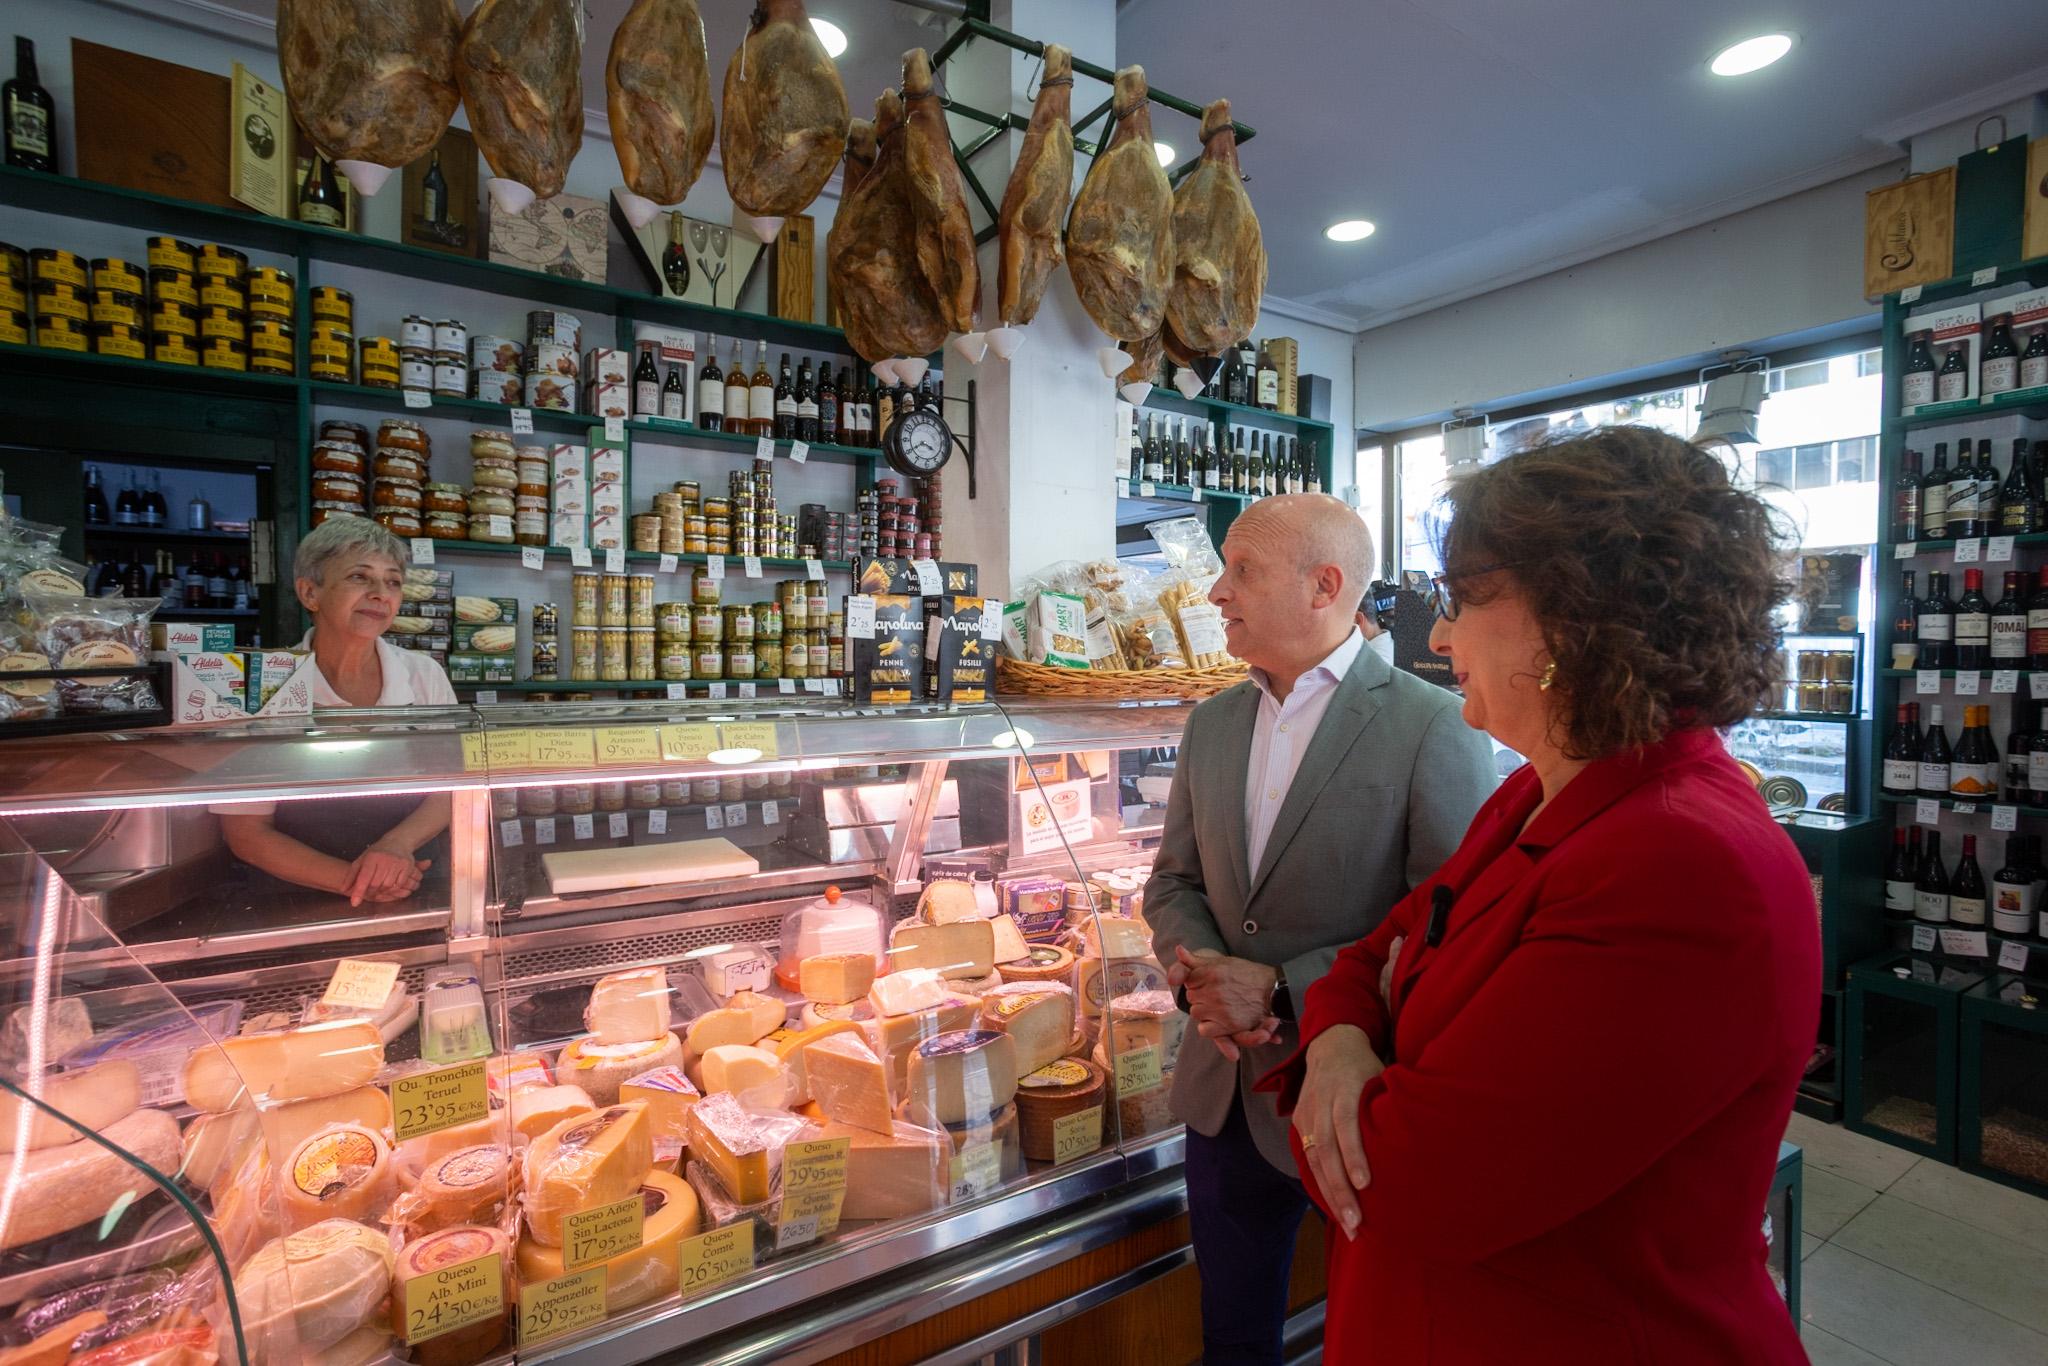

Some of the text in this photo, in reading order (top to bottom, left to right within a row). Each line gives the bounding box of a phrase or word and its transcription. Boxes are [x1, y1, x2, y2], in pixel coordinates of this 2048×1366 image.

[874, 613, 924, 636] apolina
[942, 614, 983, 636] Napol
[1992, 622, 2026, 633] POMAL
[538, 747, 572, 761] 17'95
[606, 744, 635, 757] 9'50
[668, 741, 701, 754] 10'95
[398, 1065, 484, 1093] Qu. Tronchón
[1120, 1073, 1147, 1090] 28'50
[423, 1083, 462, 1101] Teruel
[400, 1102, 456, 1130] 23'95
[804, 1144, 832, 1153] Queso
[1058, 1136, 1086, 1155] 20'50
[788, 1167, 826, 1187] 29'95
[569, 1199, 638, 1227] Queso Añejo
[573, 1215, 633, 1241] Sin Lactosa
[703, 1231, 734, 1246] Queso
[573, 1236, 617, 1261] 17'95
[437, 1265, 477, 1284] Queso
[684, 1260, 729, 1287] 26'50
[428, 1274, 487, 1303] Alb. Mini
[546, 1276, 582, 1293] Queso
[532, 1284, 599, 1313] Appenzeller
[410, 1299, 472, 1332] 24'50
[525, 1306, 578, 1335] 29'95
